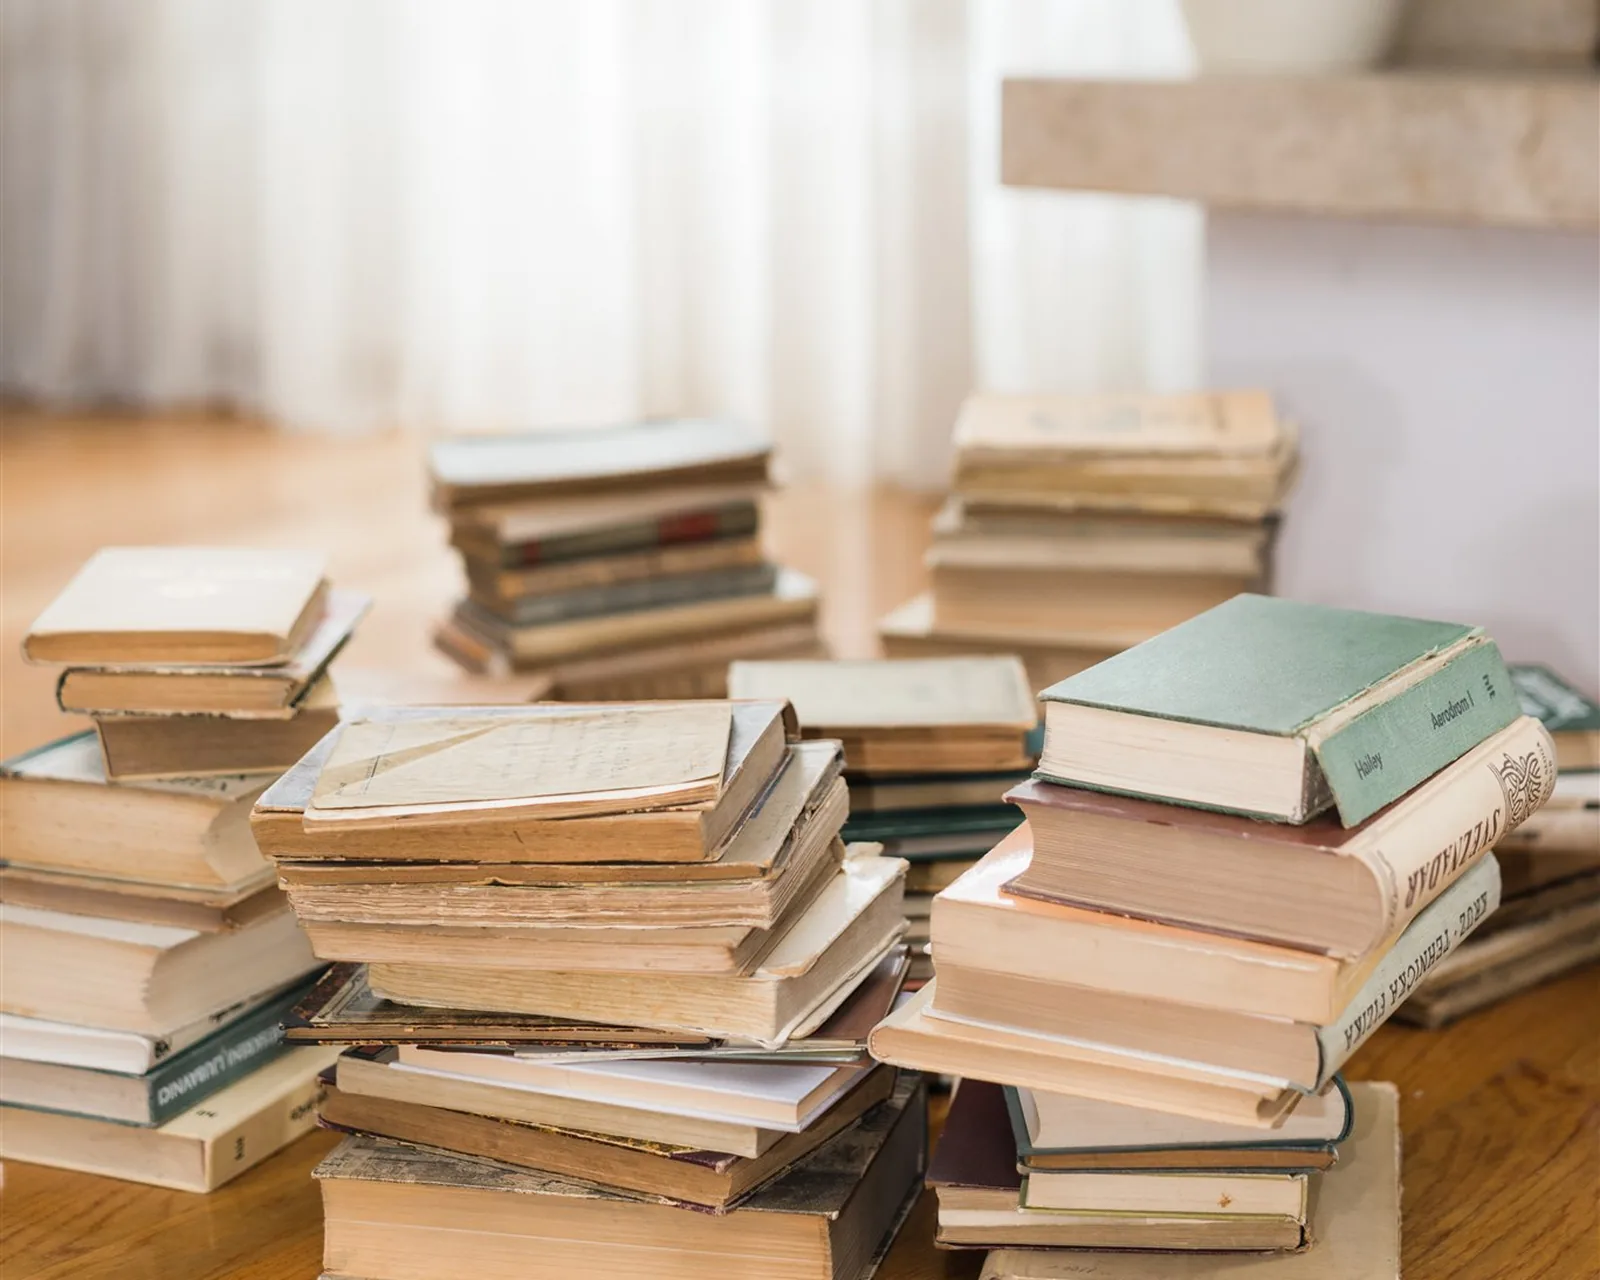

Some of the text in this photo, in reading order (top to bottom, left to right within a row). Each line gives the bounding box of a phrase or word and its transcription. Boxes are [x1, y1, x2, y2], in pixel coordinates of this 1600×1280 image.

[1430, 697, 1469, 730] Aerodrom
[1354, 752, 1384, 781] Hailey
[1404, 807, 1501, 910] SVEZNADAR
[1459, 891, 1488, 938] KRUZ
[1343, 992, 1386, 1052] FIZIKA
